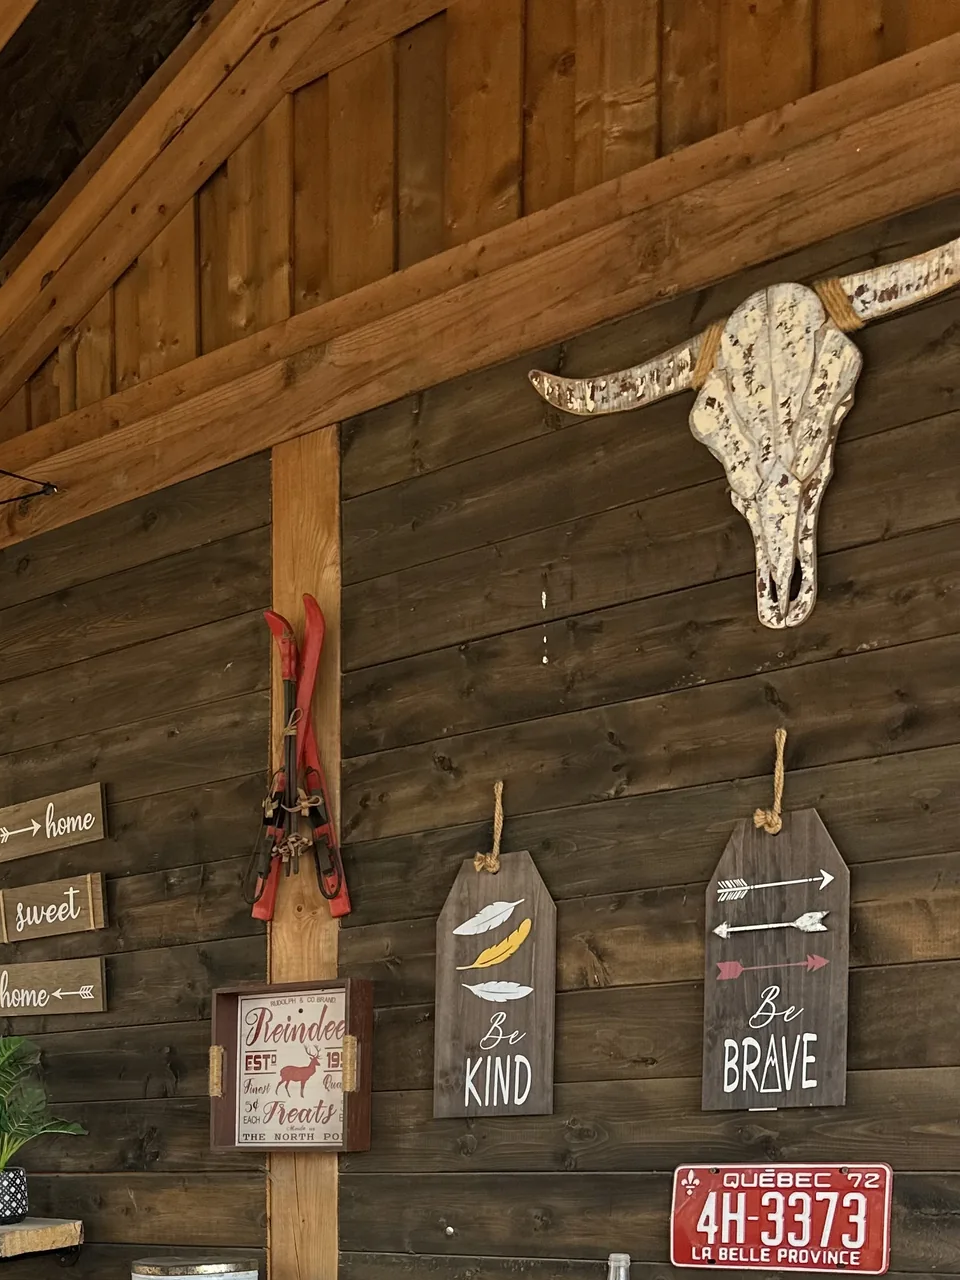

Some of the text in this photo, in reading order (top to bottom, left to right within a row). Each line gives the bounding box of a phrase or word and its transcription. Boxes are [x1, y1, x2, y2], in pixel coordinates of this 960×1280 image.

[45, 802, 96, 838] home
[15, 886, 81, 933] sweet
[0, 970, 50, 1008] home
[270, 997, 297, 1007] RUDOLPH
[748, 985, 804, 1029] Be
[479, 1011, 527, 1050] Be
[464, 1054, 532, 1107] KIND
[723, 1032, 818, 1093] BRAVE
[243, 1077, 271, 1095] Finest
[243, 1115, 261, 1125] EACH
[262, 1098, 338, 1125] Treats
[242, 1132, 266, 1141] THE
[274, 1132, 315, 1141] NORTH
[722, 1168, 880, 1189] QUÉBEC 72
[696, 1191, 868, 1250] 4H-3373
[691, 1247, 861, 1266] LA BELLE PROVINCE
